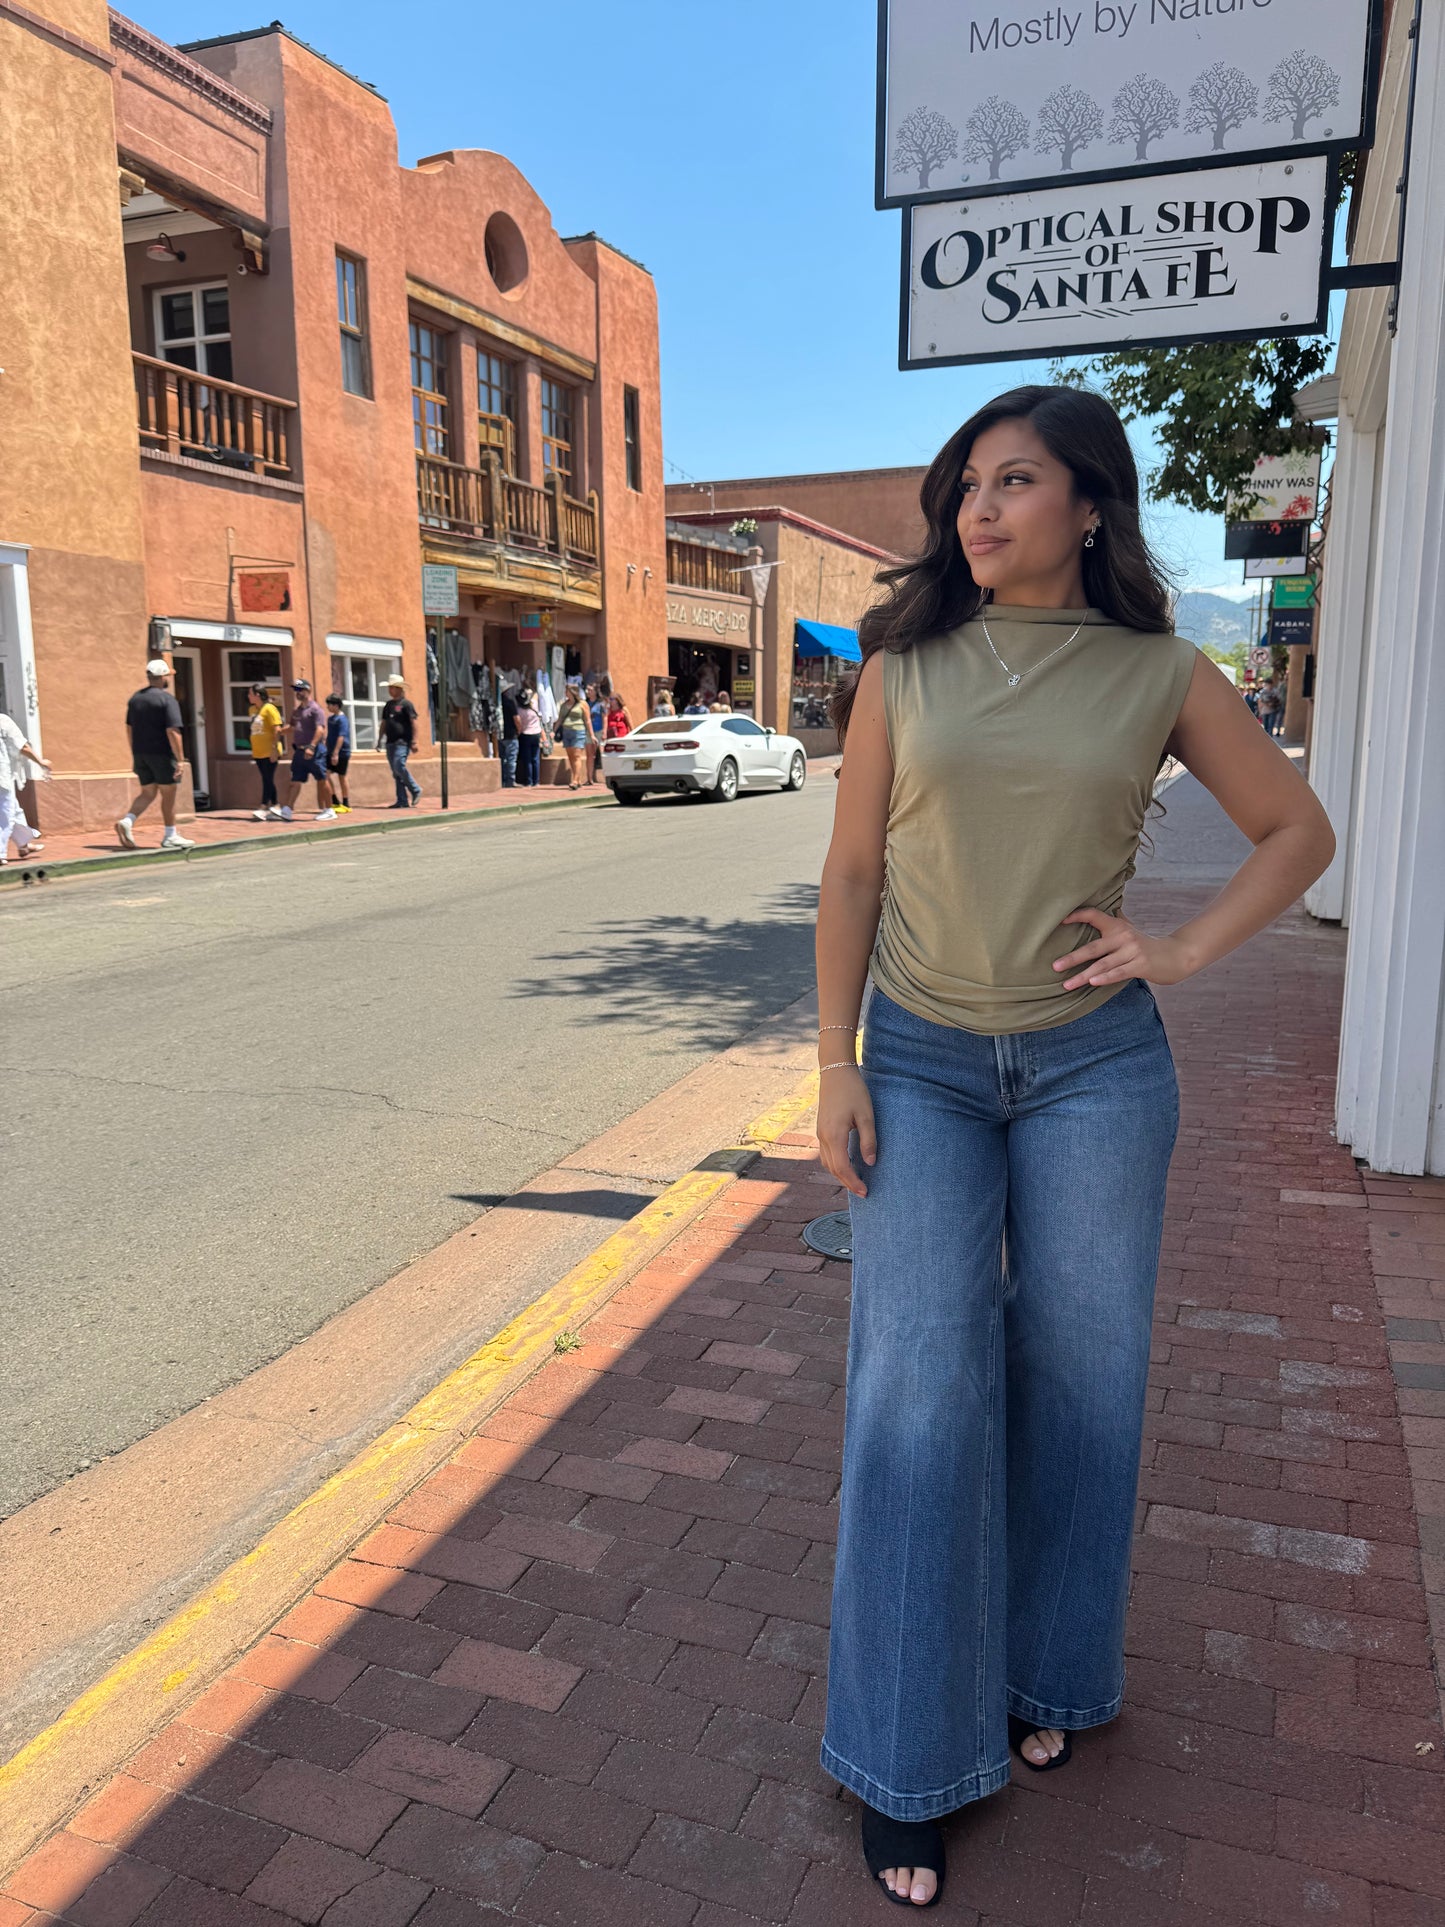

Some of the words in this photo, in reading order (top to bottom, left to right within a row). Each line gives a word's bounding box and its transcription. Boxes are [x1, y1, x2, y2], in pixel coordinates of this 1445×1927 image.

[969, 7, 1082, 53] Mostly
[1094, 0, 1137, 38] by
[920, 204, 1144, 290] OPTICAL
[1155, 195, 1311, 255] SHOP
[1084, 241, 1132, 267] OF
[981, 268, 1152, 325] SANTA
[1166, 246, 1238, 300] FE
[1286, 476, 1316, 488] WAS
[691, 606, 748, 635] MERCADO
